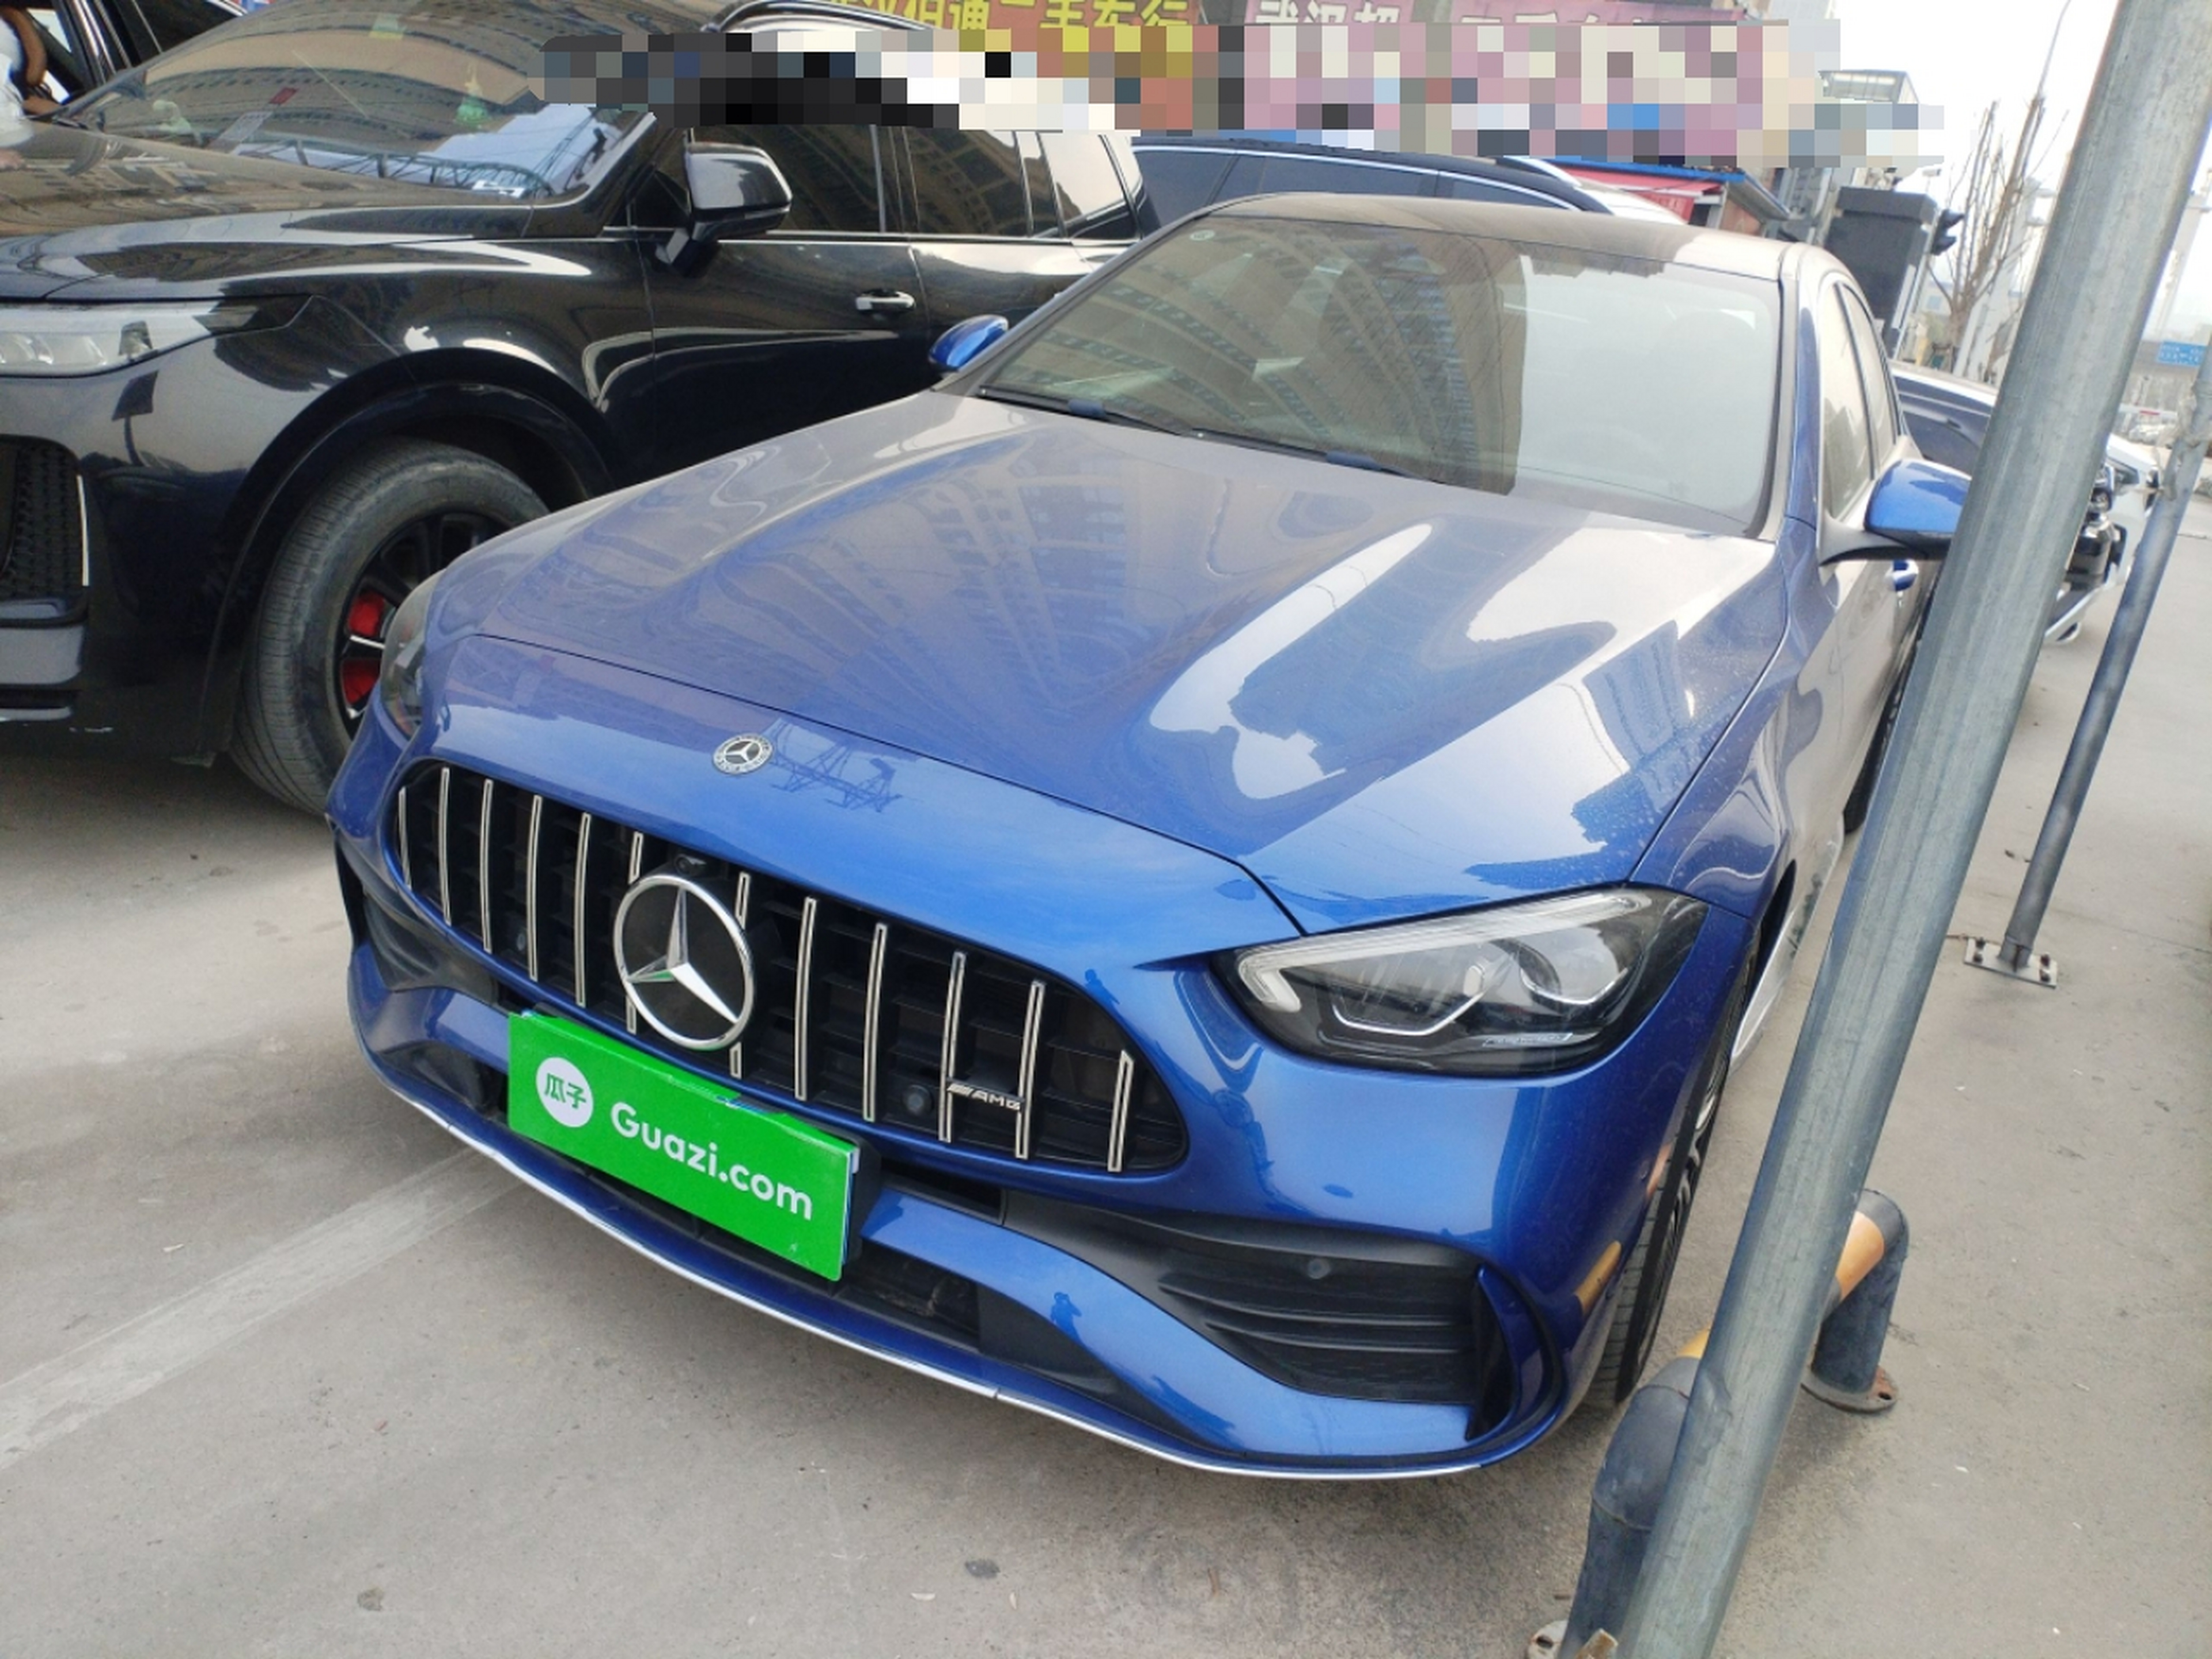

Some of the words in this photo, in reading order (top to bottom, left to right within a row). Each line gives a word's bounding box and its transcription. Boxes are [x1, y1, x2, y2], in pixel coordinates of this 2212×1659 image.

[544, 1072, 587, 1109] 瓜子
[971, 1089, 1021, 1111] AMG
[611, 1101, 813, 1221] Guazi.com
